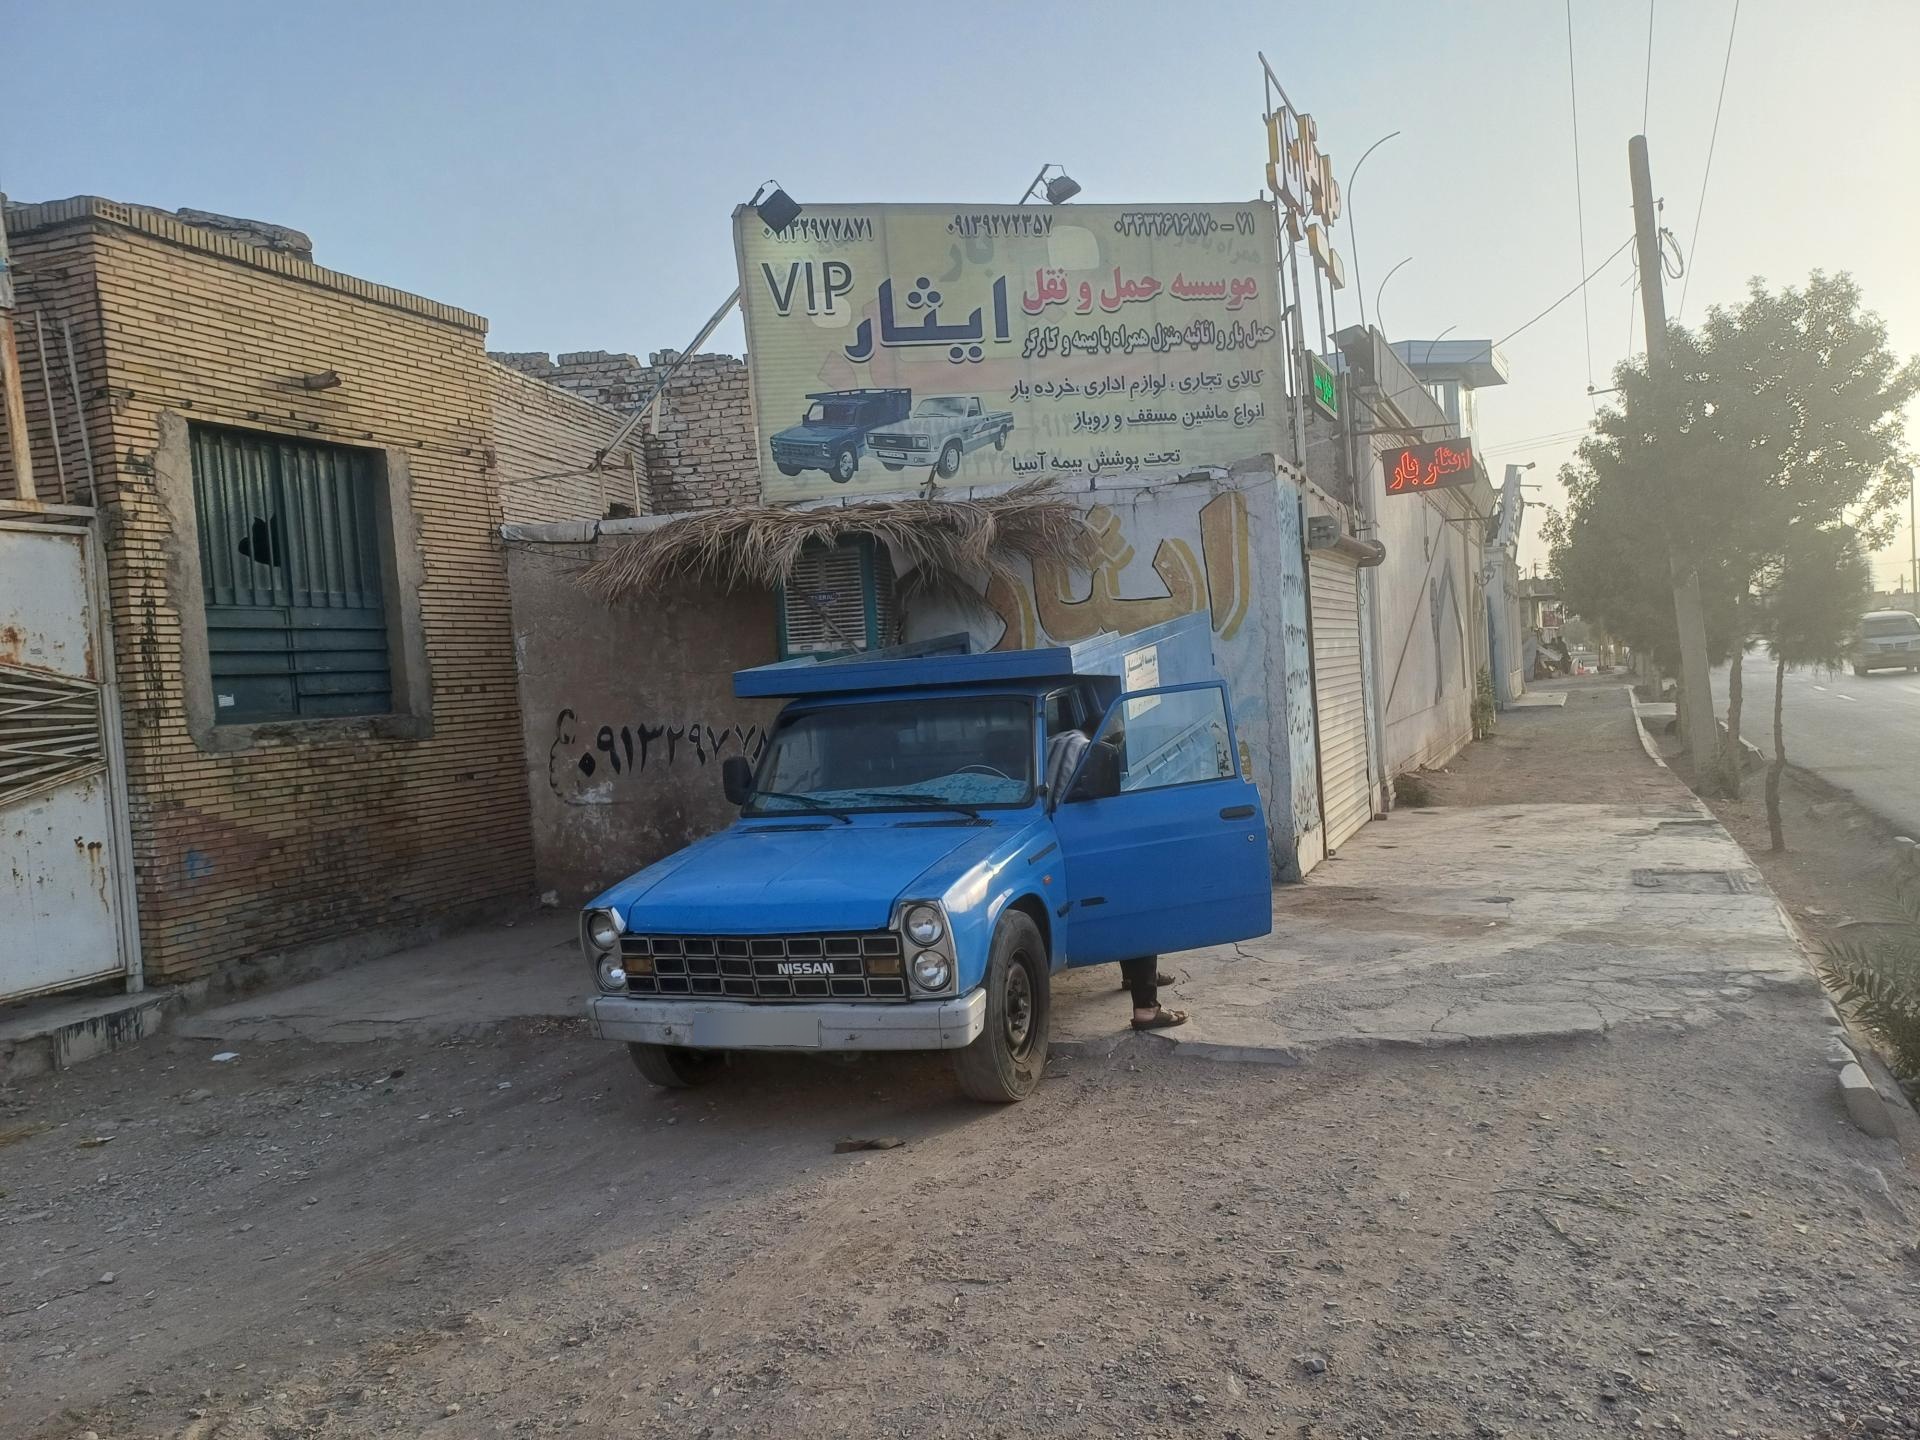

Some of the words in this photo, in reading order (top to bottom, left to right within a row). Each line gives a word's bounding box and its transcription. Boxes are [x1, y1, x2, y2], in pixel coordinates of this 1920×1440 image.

[947, 213, 1053, 235] ۰۹۱۳۹۲۷۲۳۵۷
[761, 261, 853, 312] VIP
[1022, 267, 1069, 311] نقل
[1075, 281, 1093, 311] و
[1100, 266, 1162, 309] حمل
[1171, 272, 1257, 309] موسسه
[844, 275, 1009, 358] ایثار
[1021, 327, 1060, 358] کارگر
[1071, 330, 1099, 354] بیمه
[1099, 324, 1111, 353] با
[1112, 324, 1149, 354] همراه
[1151, 322, 1183, 352] منزل
[1215, 326, 1226, 350] و
[1227, 321, 1245, 349] بار
[1245, 319, 1276, 347] حمل
[1061, 335, 1071, 356] و
[1010, 379, 1030, 400] بار
[1084, 375, 1125, 396] اداری
[1129, 373, 1166, 398] لوازم
[1178, 372, 1223, 391] تجاری
[1227, 369, 1264, 389] کالای
[1113, 416, 1123, 430] و
[1126, 408, 1178, 423] مسقف
[1182, 404, 1229, 426] ماشین
[1233, 402, 1265, 424] انواع
[1012, 451, 1047, 476] آسیا
[1051, 458, 1083, 473] بیمه
[1087, 450, 1140, 472] پوشش
[1143, 448, 1181, 464] تحت
[1389, 450, 1419, 490] بار
[777, 962, 835, 975] NISSAN
